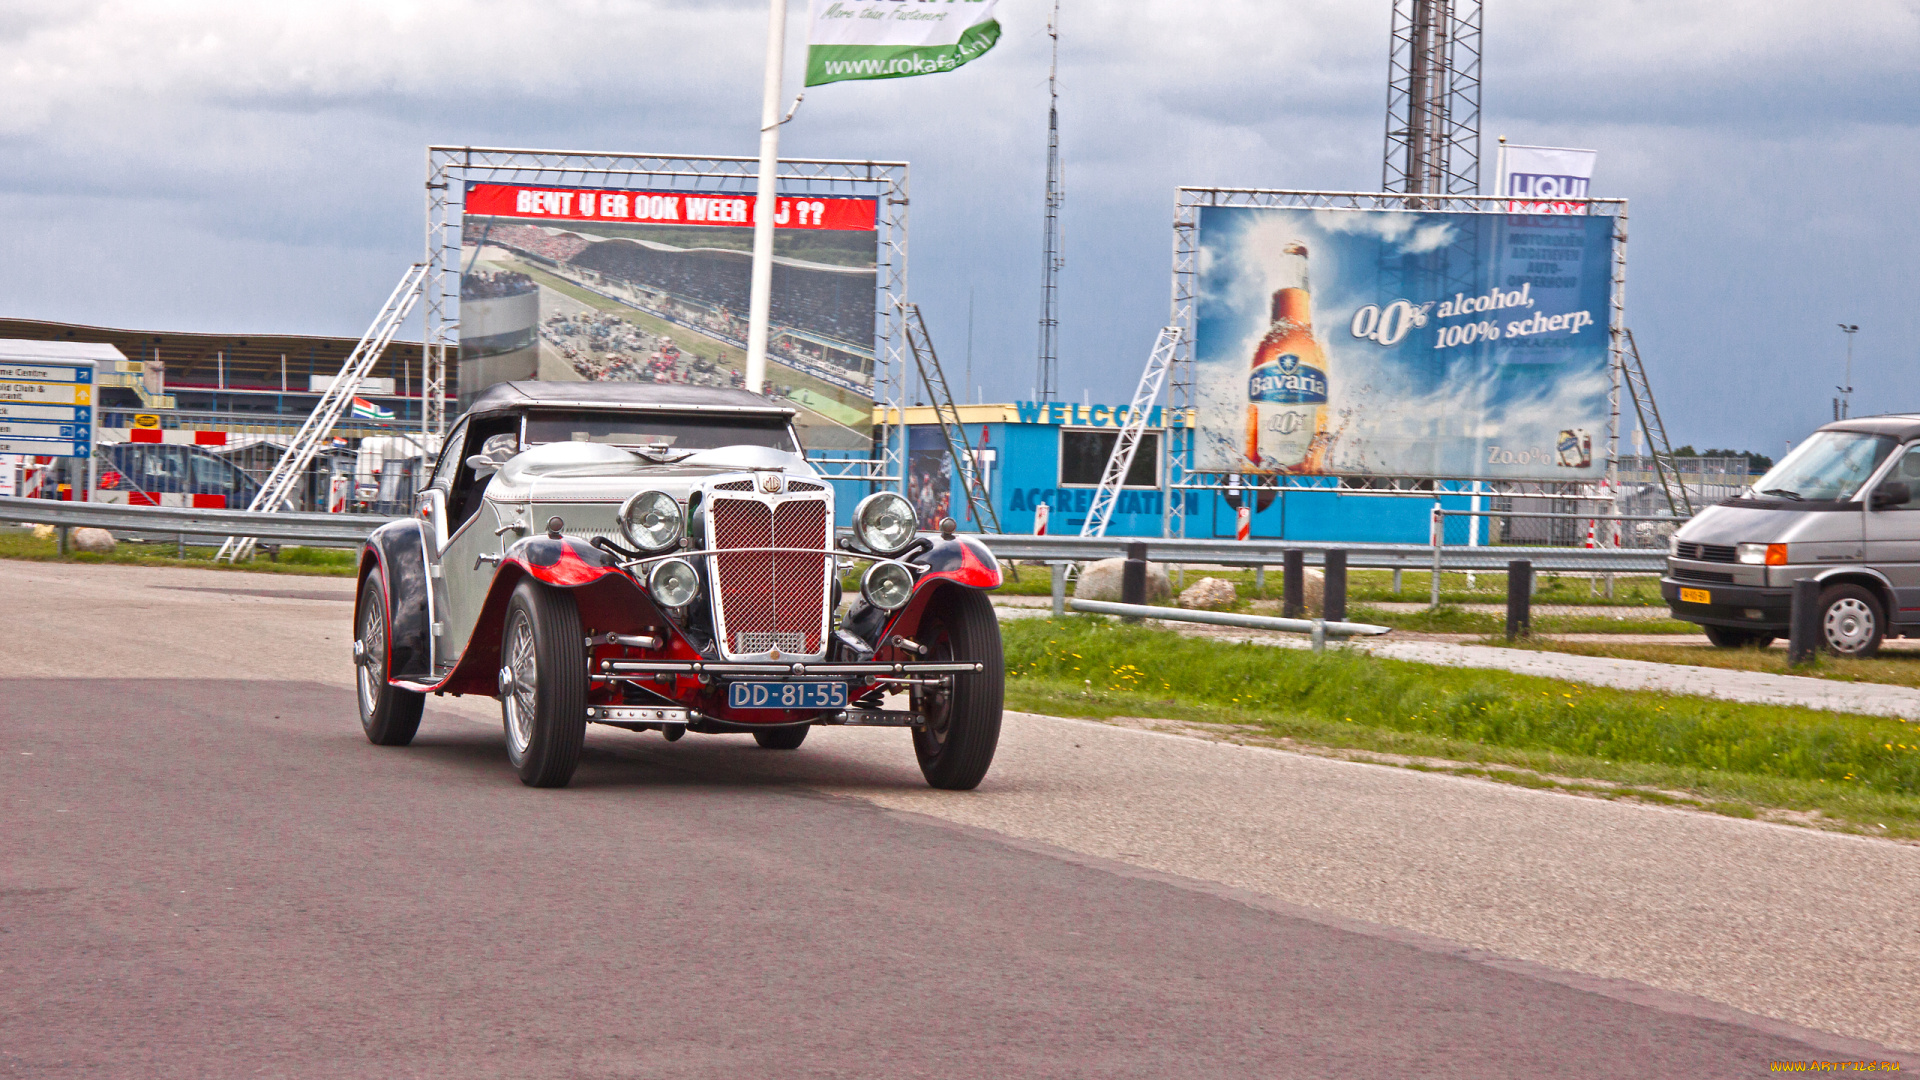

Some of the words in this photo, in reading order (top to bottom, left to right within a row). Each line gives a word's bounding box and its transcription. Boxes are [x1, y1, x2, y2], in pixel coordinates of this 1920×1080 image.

[820, 3, 855, 19] More
[859, 5, 886, 19] than
[888, 4, 949, 21] Fasteners
[1512, 175, 1587, 198] LIQUI
[517, 190, 574, 215] BENT
[579, 193, 595, 216] U
[600, 194, 629, 217] ER
[635, 195, 679, 220] OOK
[685, 197, 747, 222] WEER
[1437, 282, 1534, 318] alcohol,
[1434, 320, 1500, 349] 100%
[1505, 310, 1594, 338] scherp.
[15, 368, 48, 378] Centre
[14, 384, 35, 392] Club
[37, 385, 45, 393] &
[1251, 374, 1325, 397] Bavaria
[1010, 487, 1199, 515] ACCRETATION
[735, 684, 844, 706] DD-81-55
